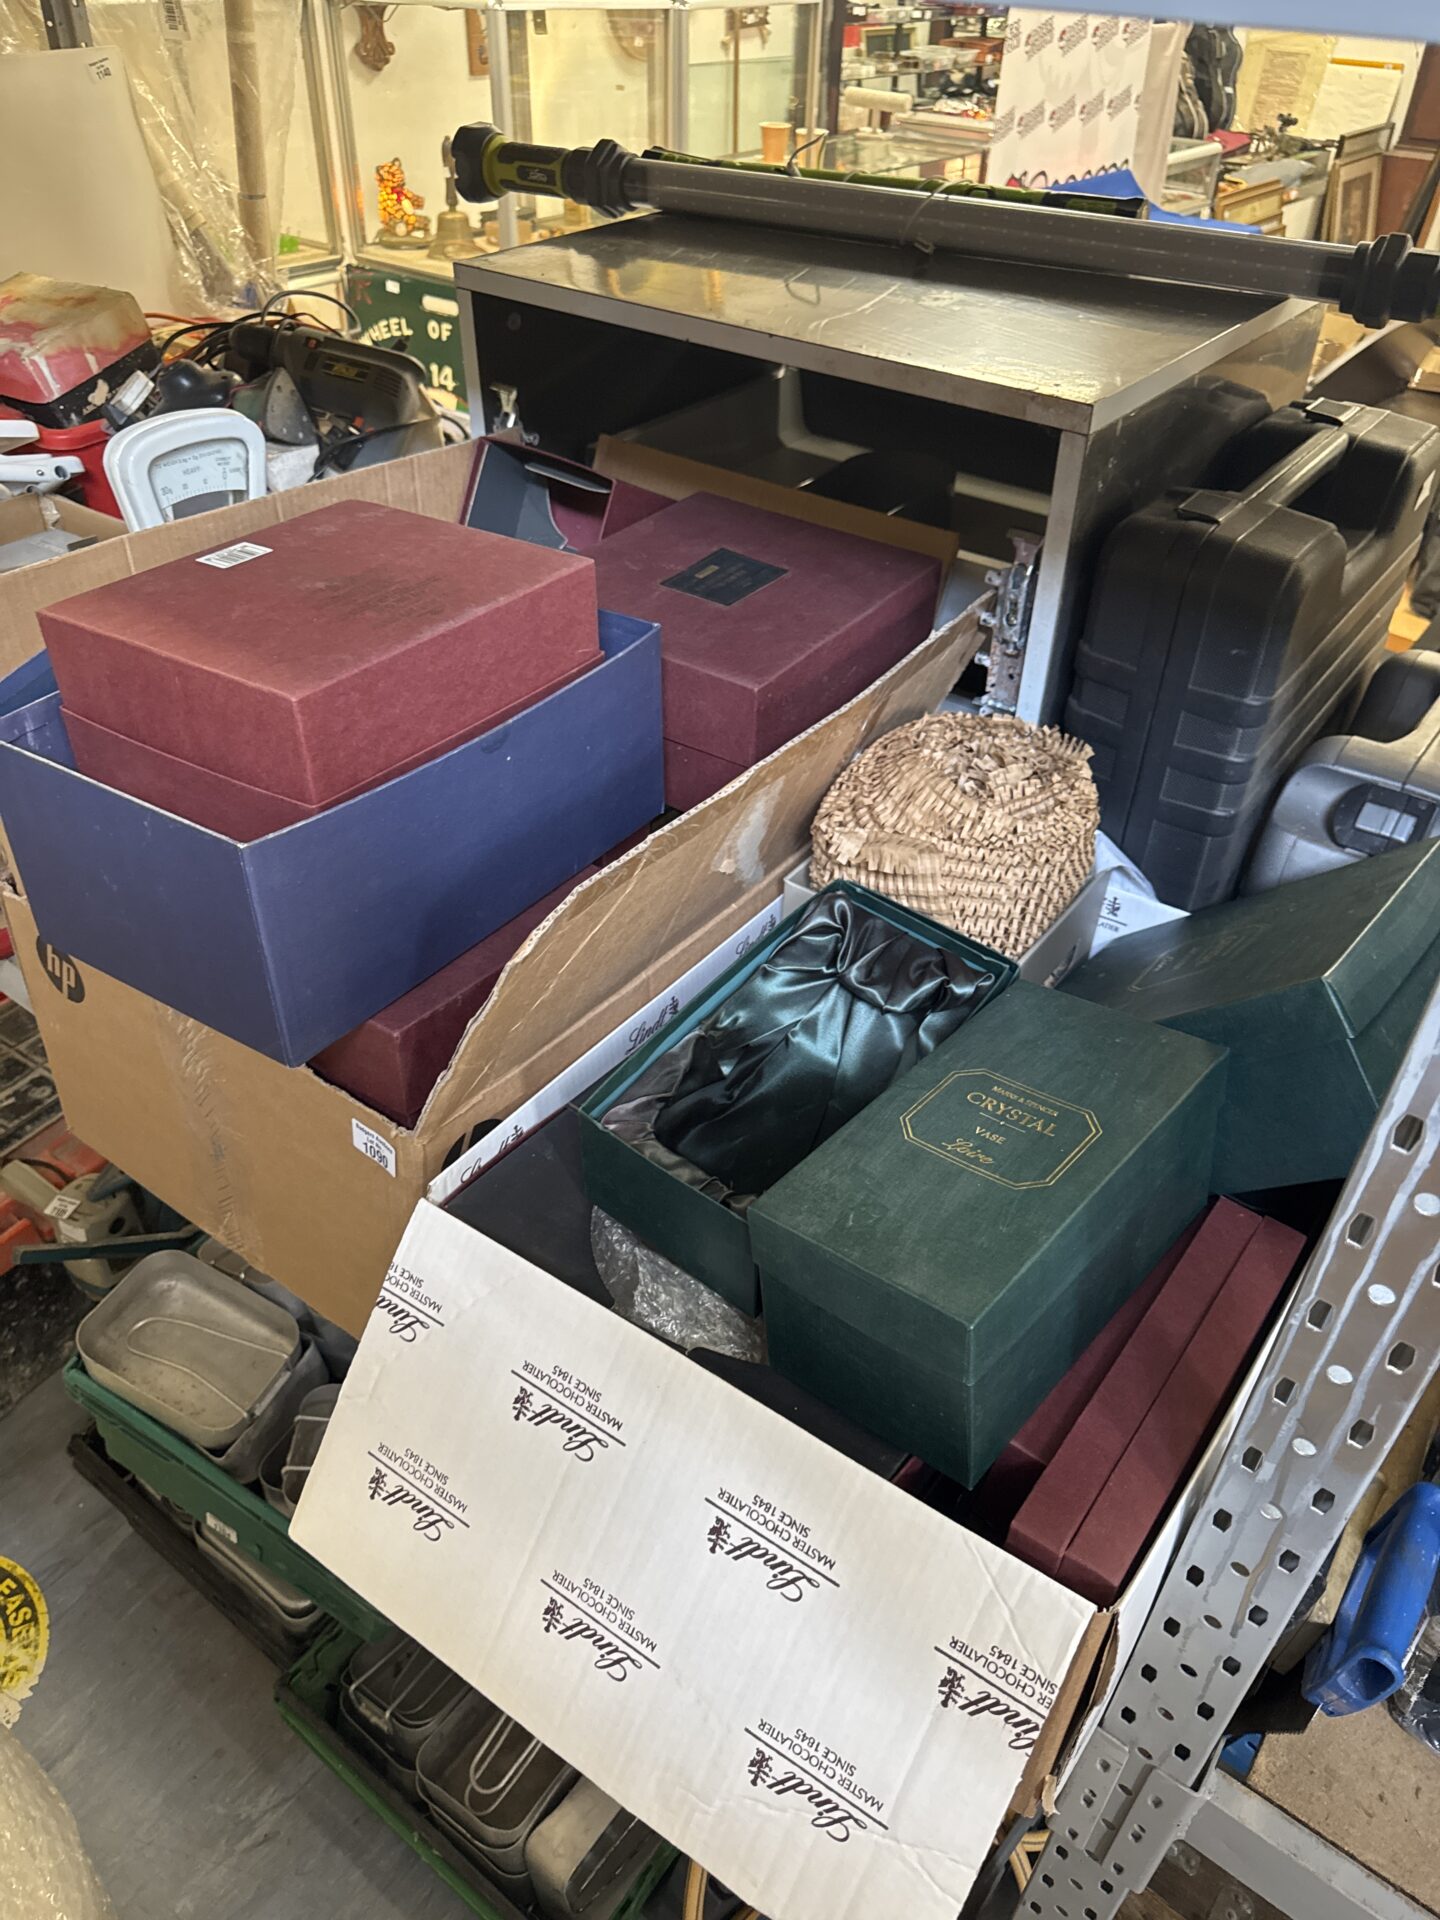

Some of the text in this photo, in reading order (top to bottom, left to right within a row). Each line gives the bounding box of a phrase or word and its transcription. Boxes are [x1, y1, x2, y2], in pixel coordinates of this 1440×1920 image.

[427, 319, 453, 342] OF
[429, 362, 460, 391] 14
[46, 943, 76, 1000] hp
[967, 1091, 1058, 1138] CRYSTAL
[975, 1126, 1007, 1145] VASE
[362, 1142, 388, 1169] 1090
[941, 1137, 995, 1165] Loire
[399, 1268, 424, 1289] SINCE
[409, 1287, 443, 1313] MASTER
[522, 1360, 623, 1431] MASTER CHOCOLATIER
[552, 1365, 602, 1403] SINCE 1845
[527, 1403, 609, 1462] Lindt
[378, 1442, 468, 1513] MASTER CHOCOLATIER
[403, 1448, 449, 1485] SINCE 1845
[381, 1484, 455, 1541] Lindt
[717, 1487, 836, 1570] MASTER CHOCOLATIER
[752, 1494, 811, 1538] SINCE 1845
[724, 1537, 820, 1602] Lindt
[552, 1569, 657, 1653] MASTER CHOCOLATIER
[582, 1577, 635, 1620] SINCE 1845
[557, 1617, 643, 1682] Lindt
[949, 1635, 1035, 1697] CHOCOLATIER
[988, 1645, 1058, 1695] SINCE 1845
[757, 1718, 884, 1812] MASTER CHOCOLATIER
[793, 1728, 857, 1777] SINCE 1845
[766, 1771, 868, 1842] Lindt
